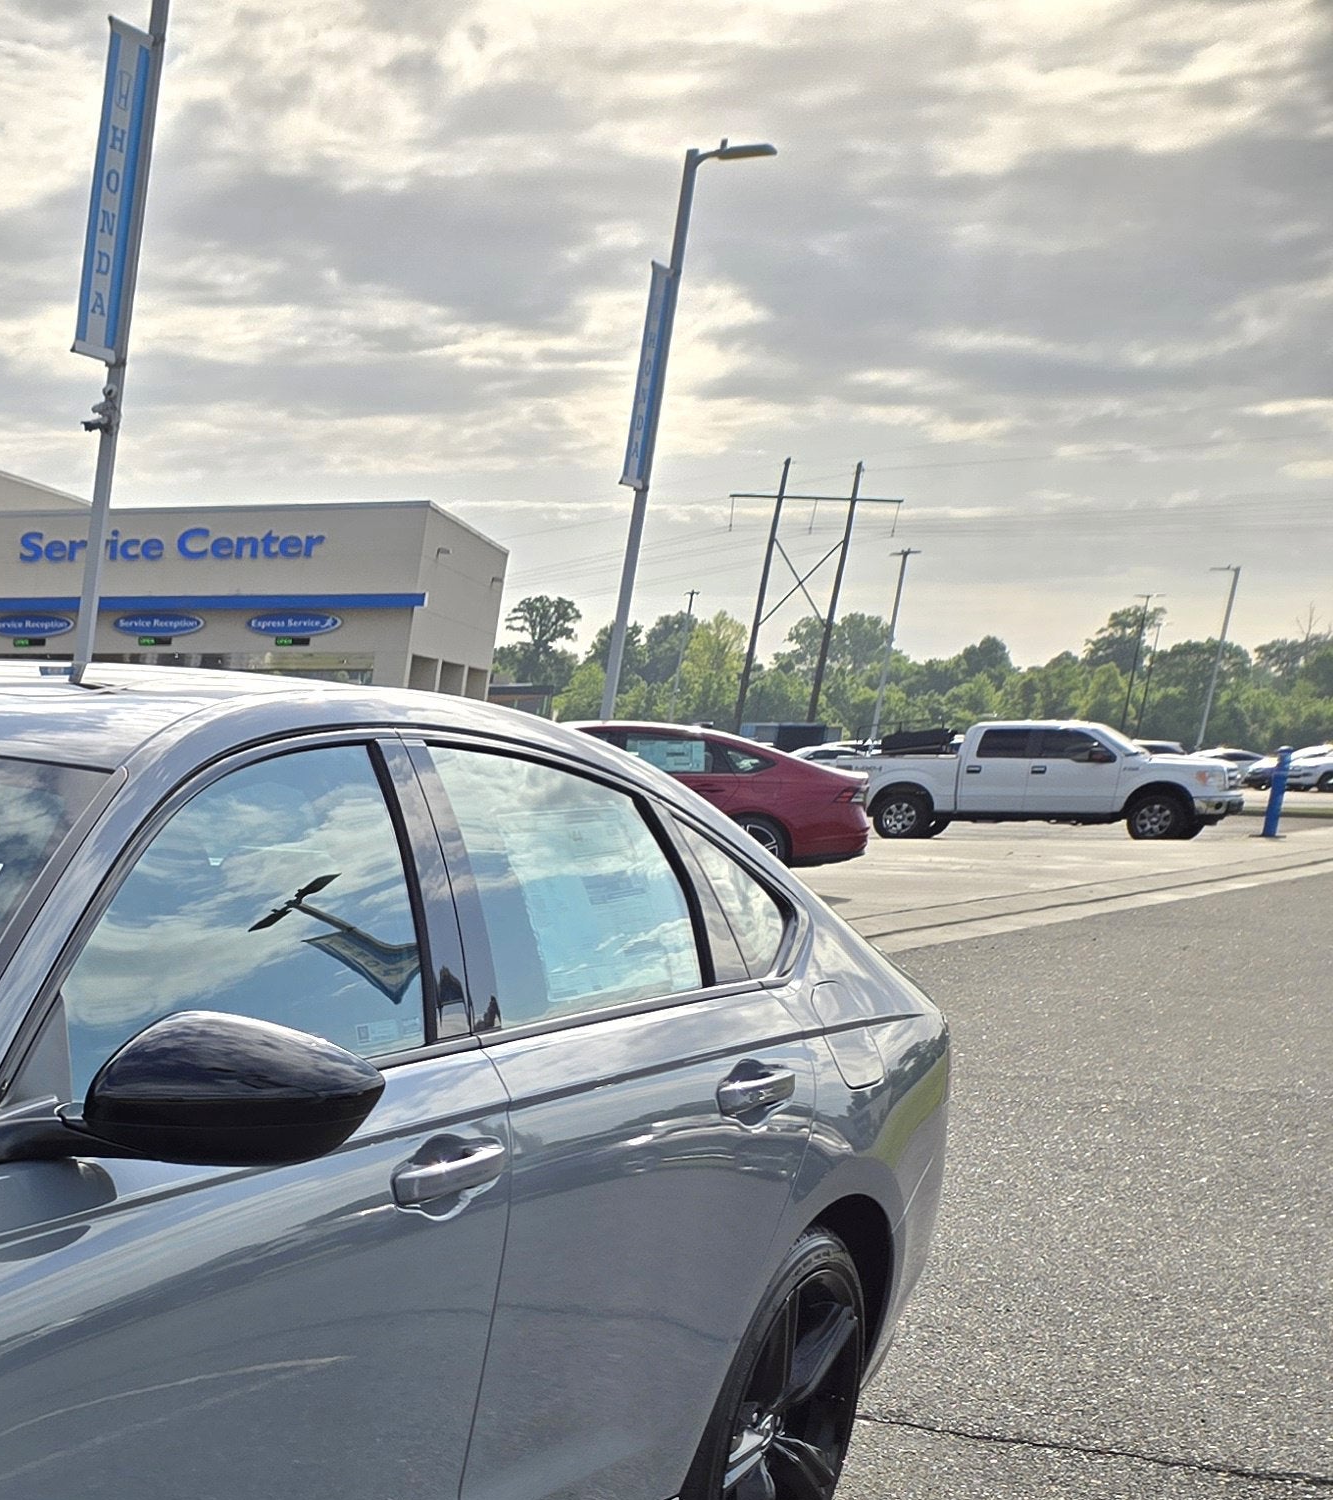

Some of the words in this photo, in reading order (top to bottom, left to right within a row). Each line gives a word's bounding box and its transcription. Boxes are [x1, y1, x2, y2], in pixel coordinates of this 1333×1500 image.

[90, 125, 126, 317] HONDA
[19, 529, 165, 562] Serice
[177, 527, 326, 560] Center
[25, 619, 68, 630] Reception
[119, 619, 151, 628] Service
[153, 619, 198, 629] Reception
[251, 618, 284, 629] Express
[288, 617, 321, 627] Service
